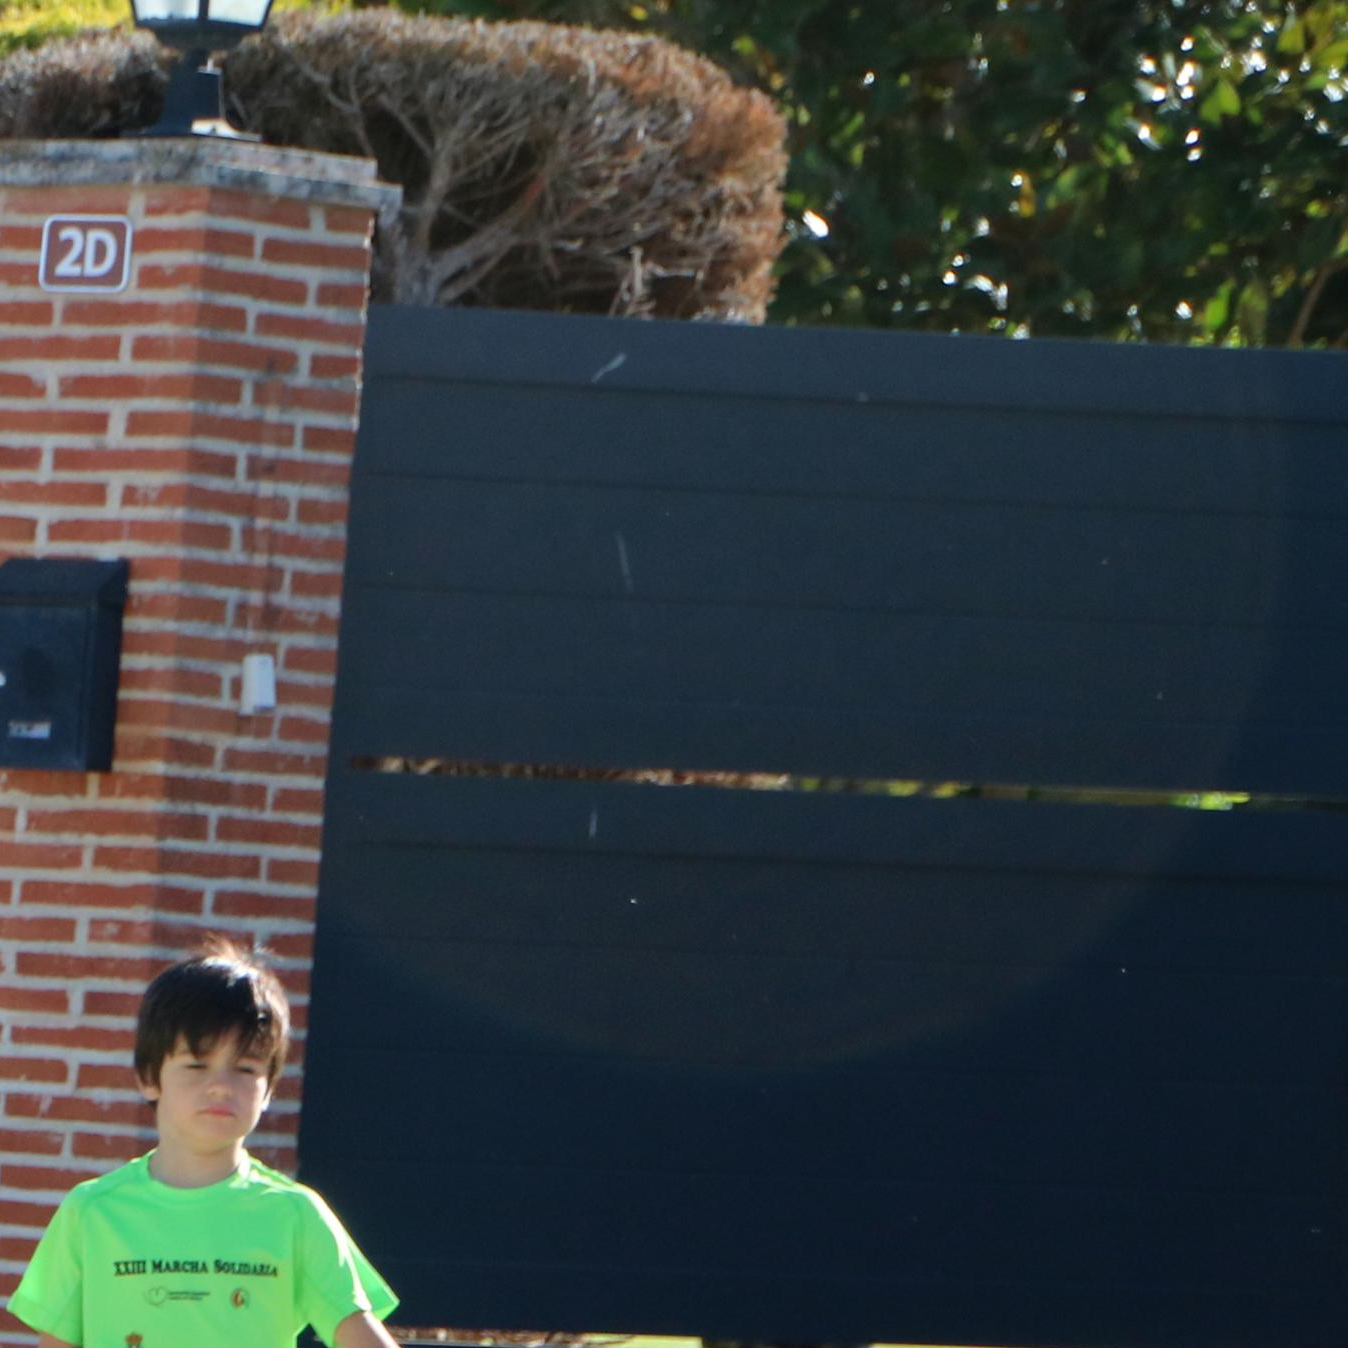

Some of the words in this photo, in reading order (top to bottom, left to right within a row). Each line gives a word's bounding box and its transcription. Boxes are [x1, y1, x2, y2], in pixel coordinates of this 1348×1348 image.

[55, 227, 117, 276] 2D
[114, 1260, 146, 1276] XXIII
[151, 1259, 208, 1274] MARCHA
[214, 1259, 278, 1278] SOLIDARIA
